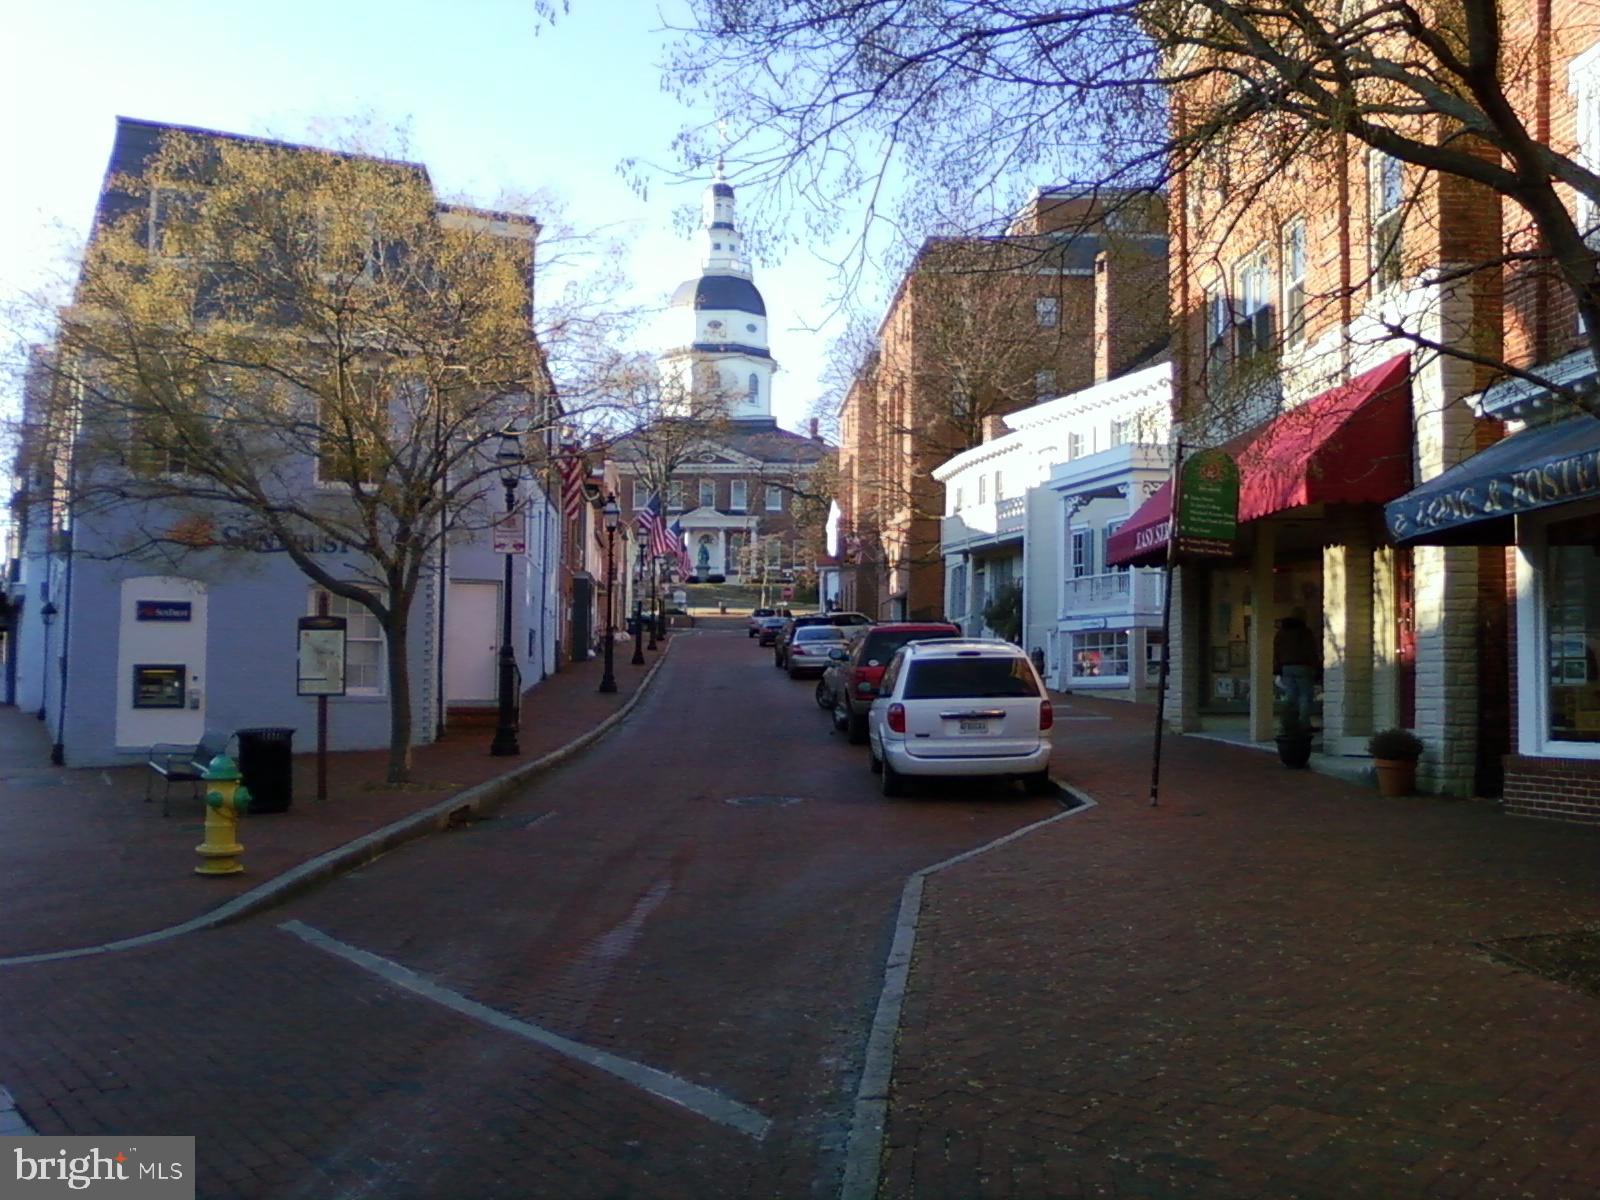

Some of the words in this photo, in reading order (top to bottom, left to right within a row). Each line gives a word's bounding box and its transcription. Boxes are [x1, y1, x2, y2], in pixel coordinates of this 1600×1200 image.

[1416, 487, 1475, 529] LONG
[1483, 479, 1503, 512] &
[1511, 450, 1600, 508] FOSTE
